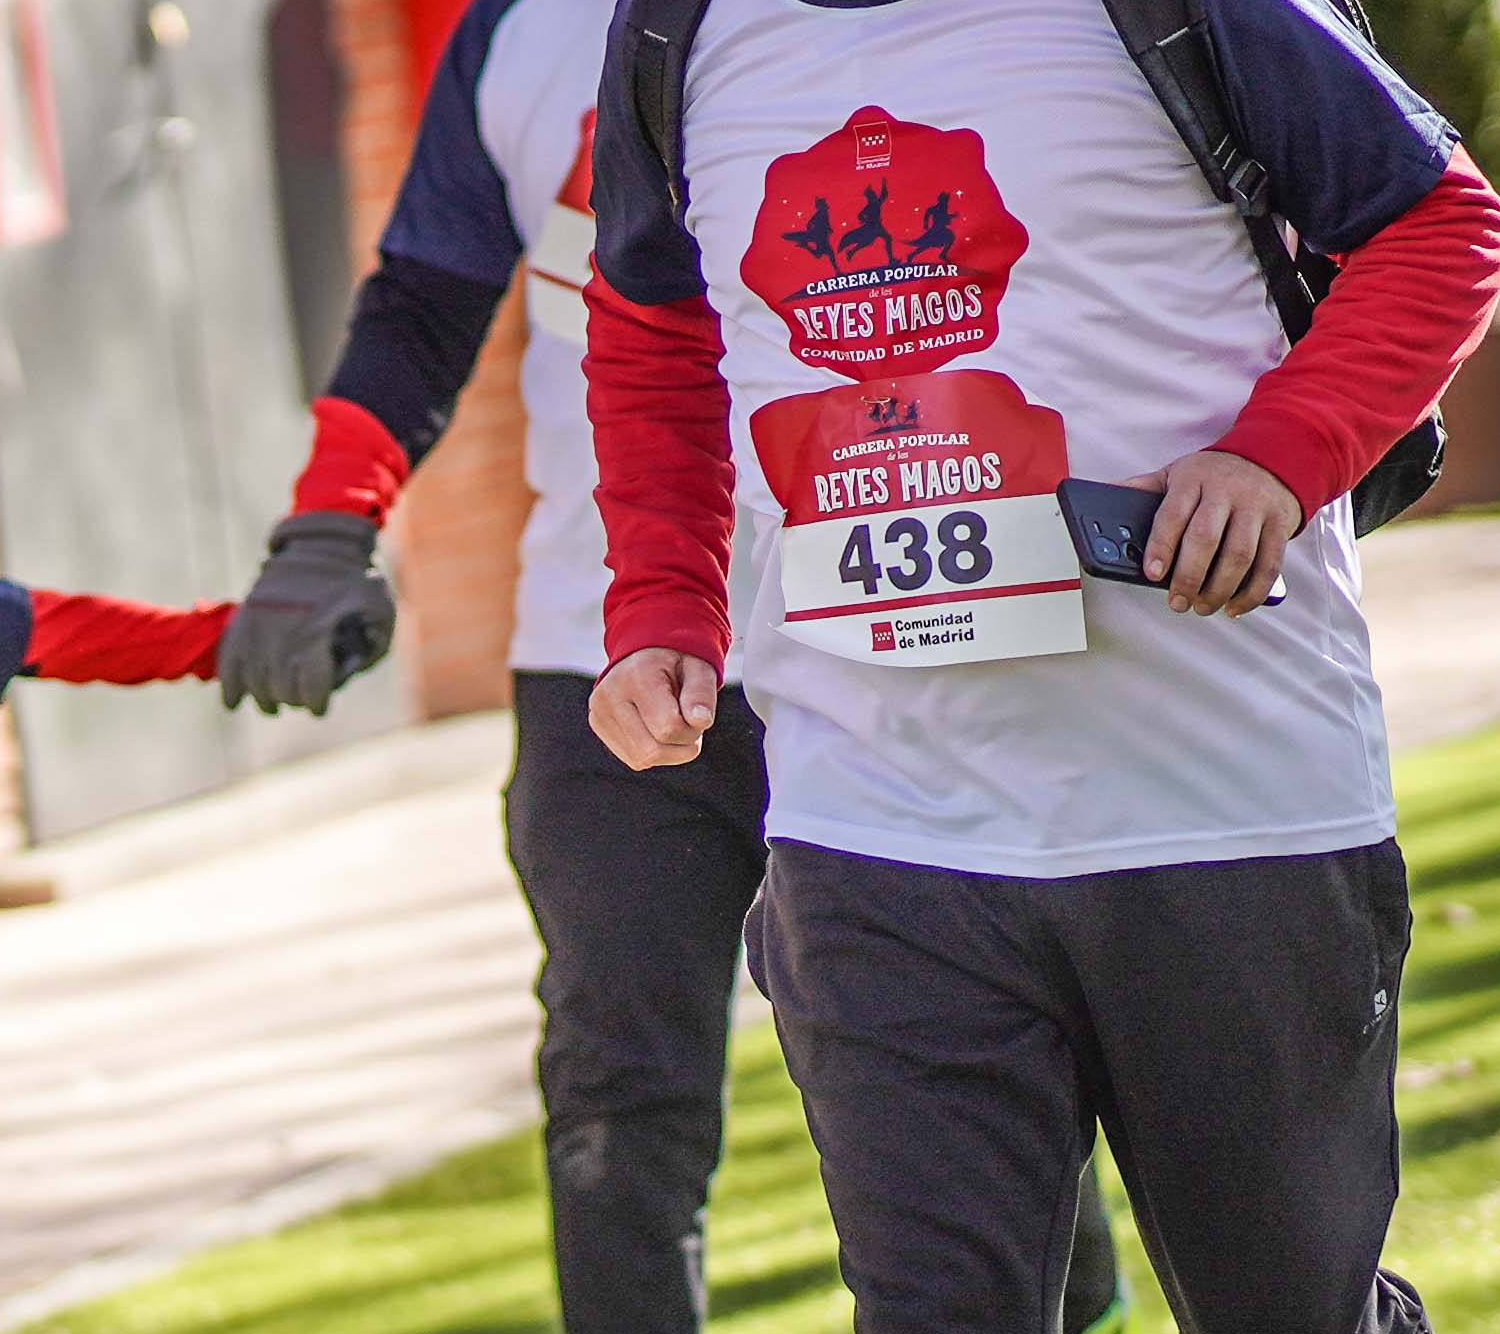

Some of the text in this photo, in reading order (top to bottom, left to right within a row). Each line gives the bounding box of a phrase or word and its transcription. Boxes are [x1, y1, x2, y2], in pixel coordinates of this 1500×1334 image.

[806, 264, 958, 296] CARRERA POPULAR
[868, 289, 880, 299] de
[793, 284, 983, 341] REYES MAGOS
[893, 342, 914, 357] DE
[918, 328, 984, 353] MADRID
[832, 433, 970, 461] CARRERA POPULAR
[814, 452, 1002, 513] REYES MAGOS
[838, 510, 993, 595] 438
[895, 611, 974, 631] Comunidad
[899, 628, 975, 649] de Madrid
